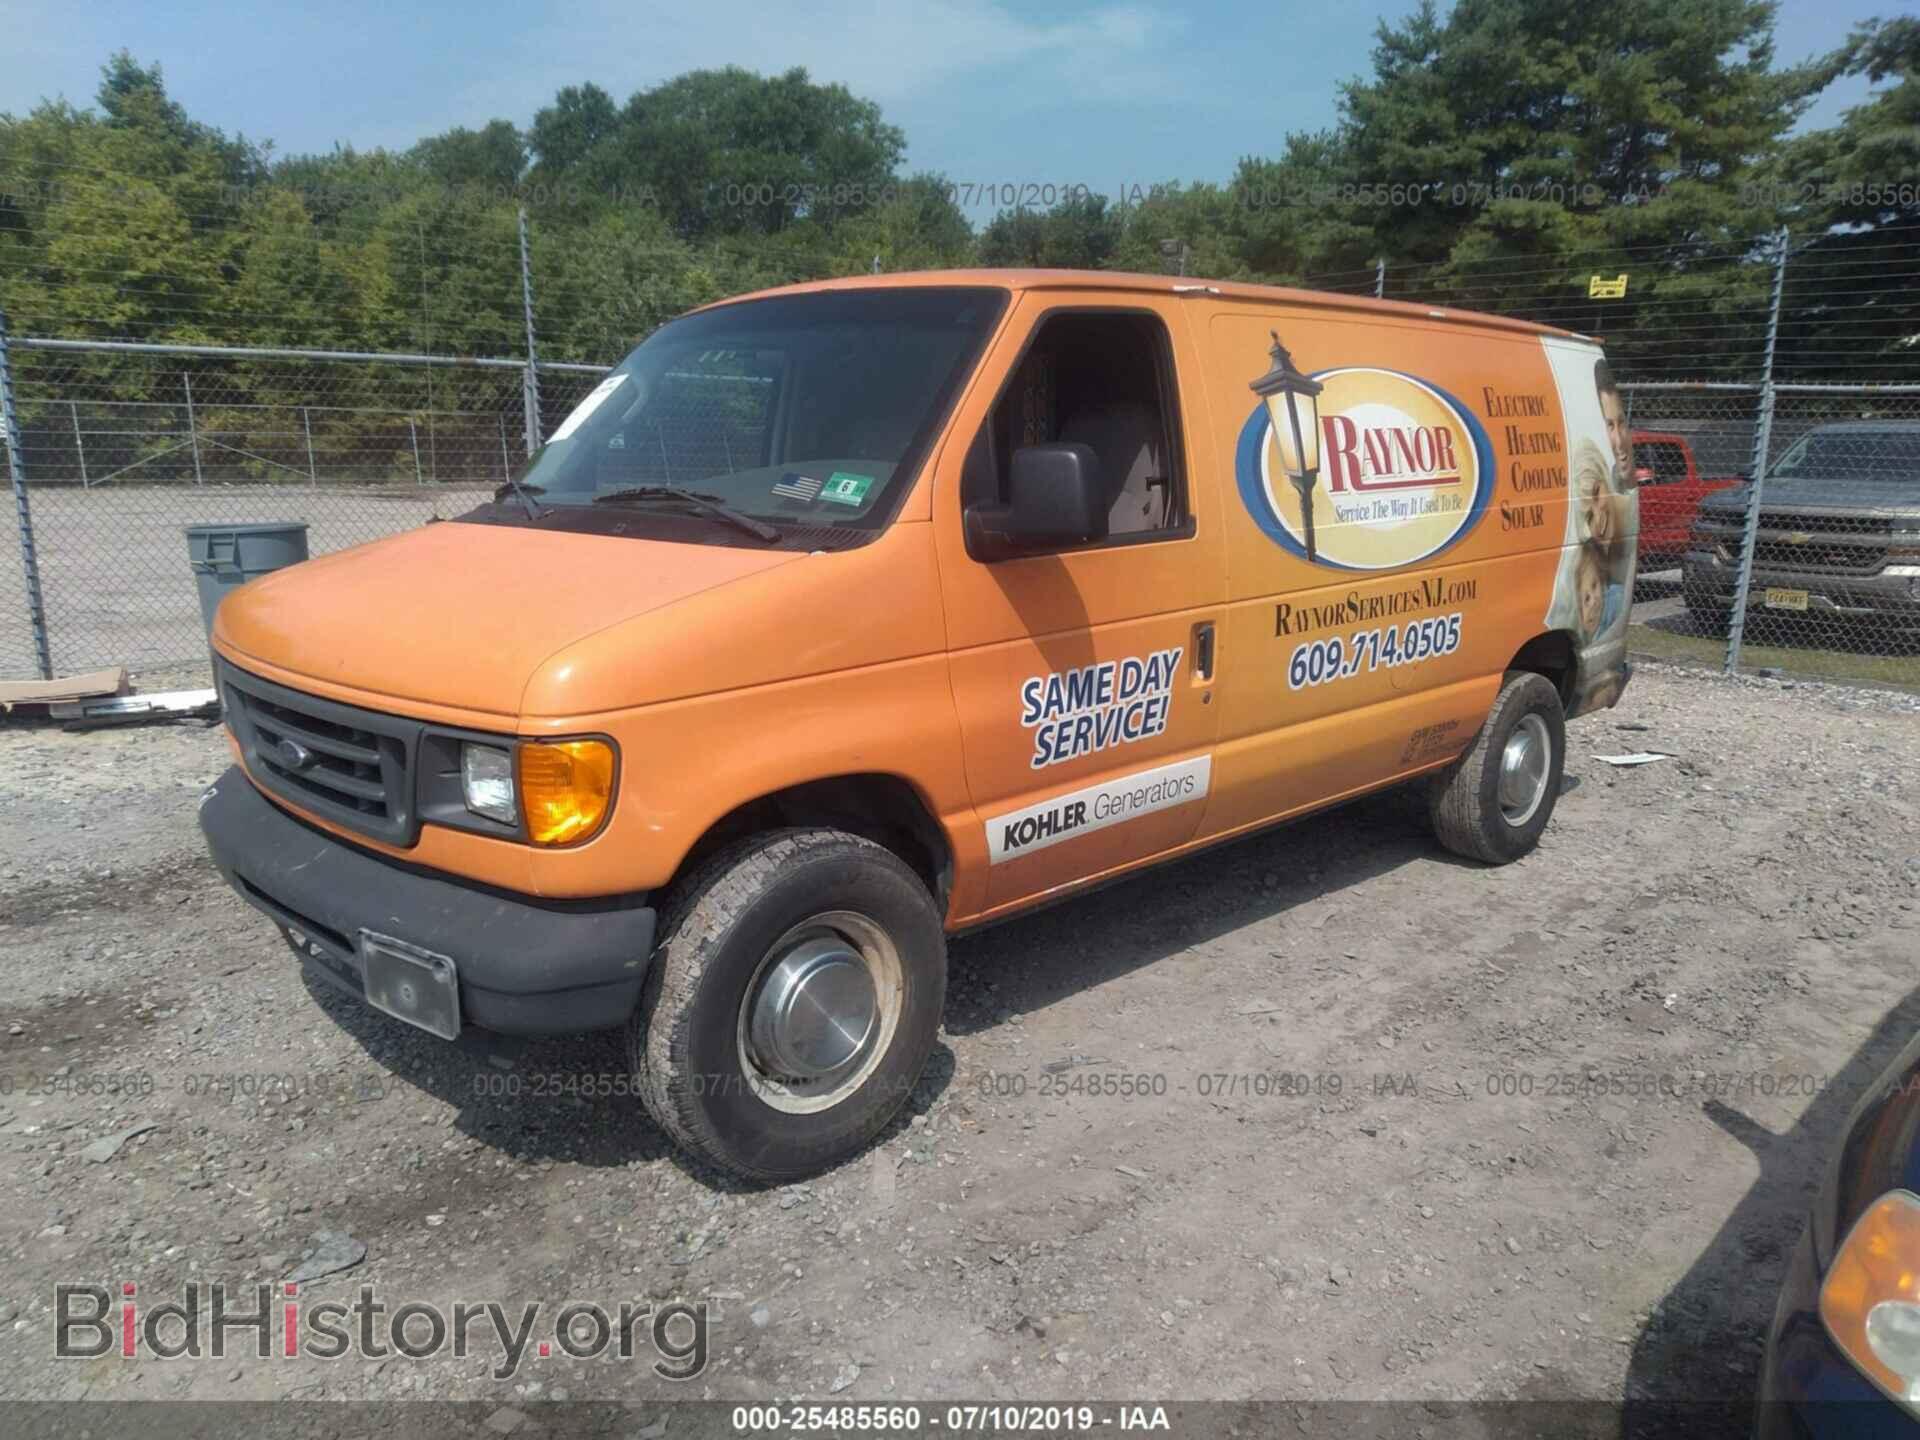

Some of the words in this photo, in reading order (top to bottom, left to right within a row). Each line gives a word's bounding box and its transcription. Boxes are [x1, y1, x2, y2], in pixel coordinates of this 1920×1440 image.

[1482, 386, 1550, 418] ELECTRIC
[1320, 415, 1458, 493] RAYNOR
[1505, 425, 1561, 456] HEATING
[1511, 462, 1567, 493] COOLING
[1335, 503, 1369, 523] Service
[1372, 501, 1389, 519] The
[1391, 499, 1409, 520] Way
[1420, 496, 1439, 513] Used
[1440, 495, 1451, 511] To
[1500, 500, 1545, 532] SOLAR
[1289, 613, 1461, 689] 609.714.0505
[1021, 661, 1115, 727] SAME
[1118, 647, 1183, 700] DAY
[1031, 695, 1171, 769] SERVICE!
[1003, 800, 1087, 851] KOHLER
[1094, 774, 1195, 820] Generators
